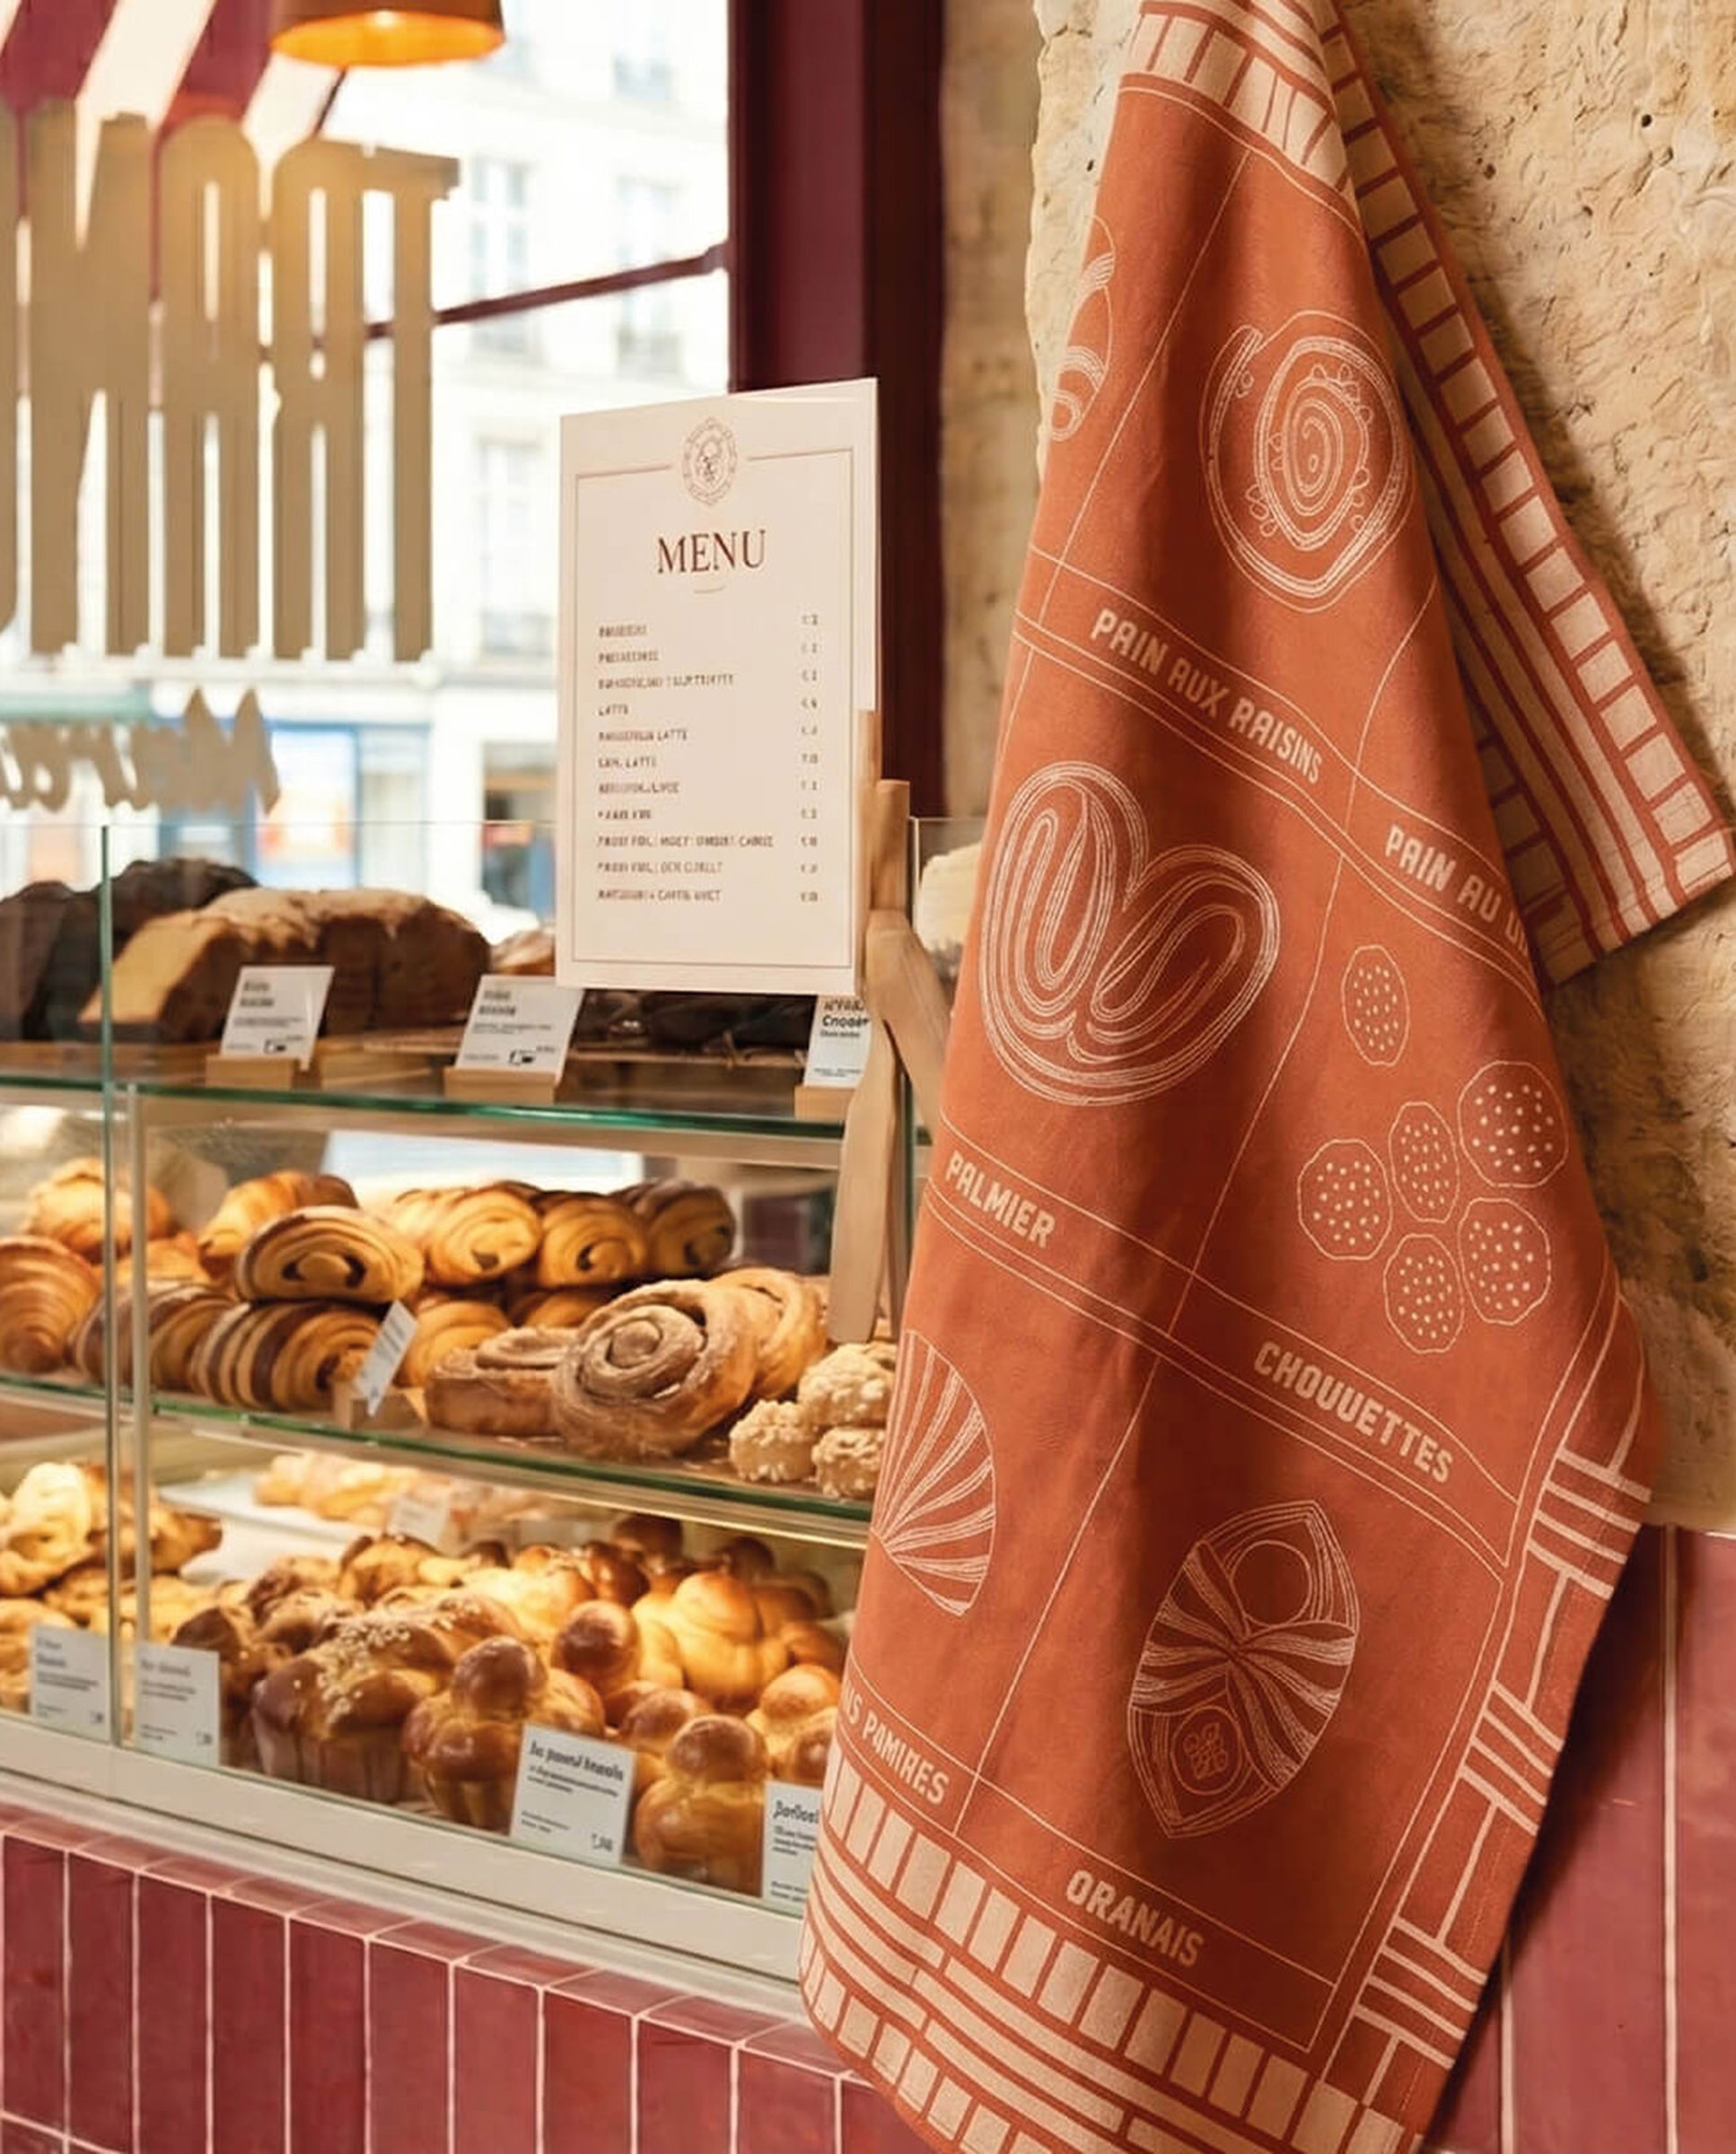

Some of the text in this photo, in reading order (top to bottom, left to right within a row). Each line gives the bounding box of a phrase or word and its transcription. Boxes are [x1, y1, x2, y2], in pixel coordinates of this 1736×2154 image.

[658, 530, 767, 574] MENU
[1090, 608, 1323, 785] PAIN AUX RAISINS
[1385, 823, 1457, 892] PAIN
[1456, 874, 1502, 924] AU
[944, 1149, 1056, 1248] PALMIER
[1065, 1869, 1205, 1969] ORANAIS
